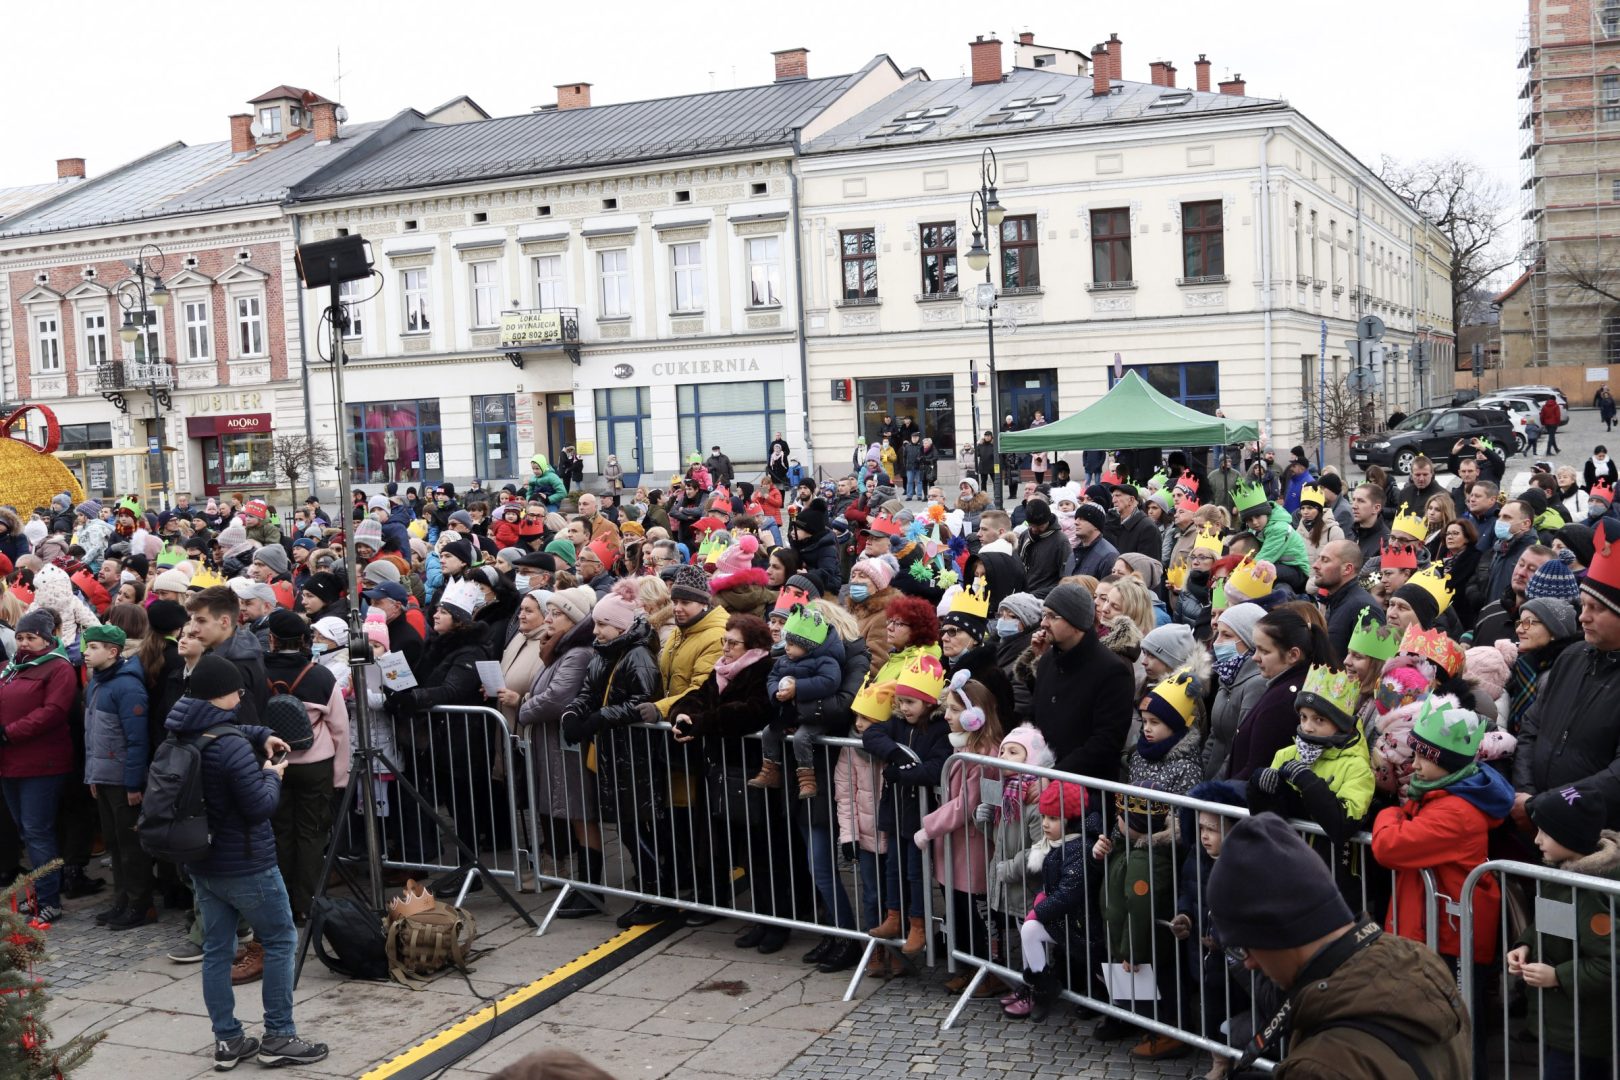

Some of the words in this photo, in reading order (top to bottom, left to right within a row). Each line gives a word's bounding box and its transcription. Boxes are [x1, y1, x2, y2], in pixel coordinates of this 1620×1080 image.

[520, 314, 542, 322] LOKAL
[652, 358, 760, 376] CUKIERNIA
[188, 392, 262, 416] JUBILER
[228, 418, 258, 428] ADORO
[1264, 998, 1292, 1039] SONY
